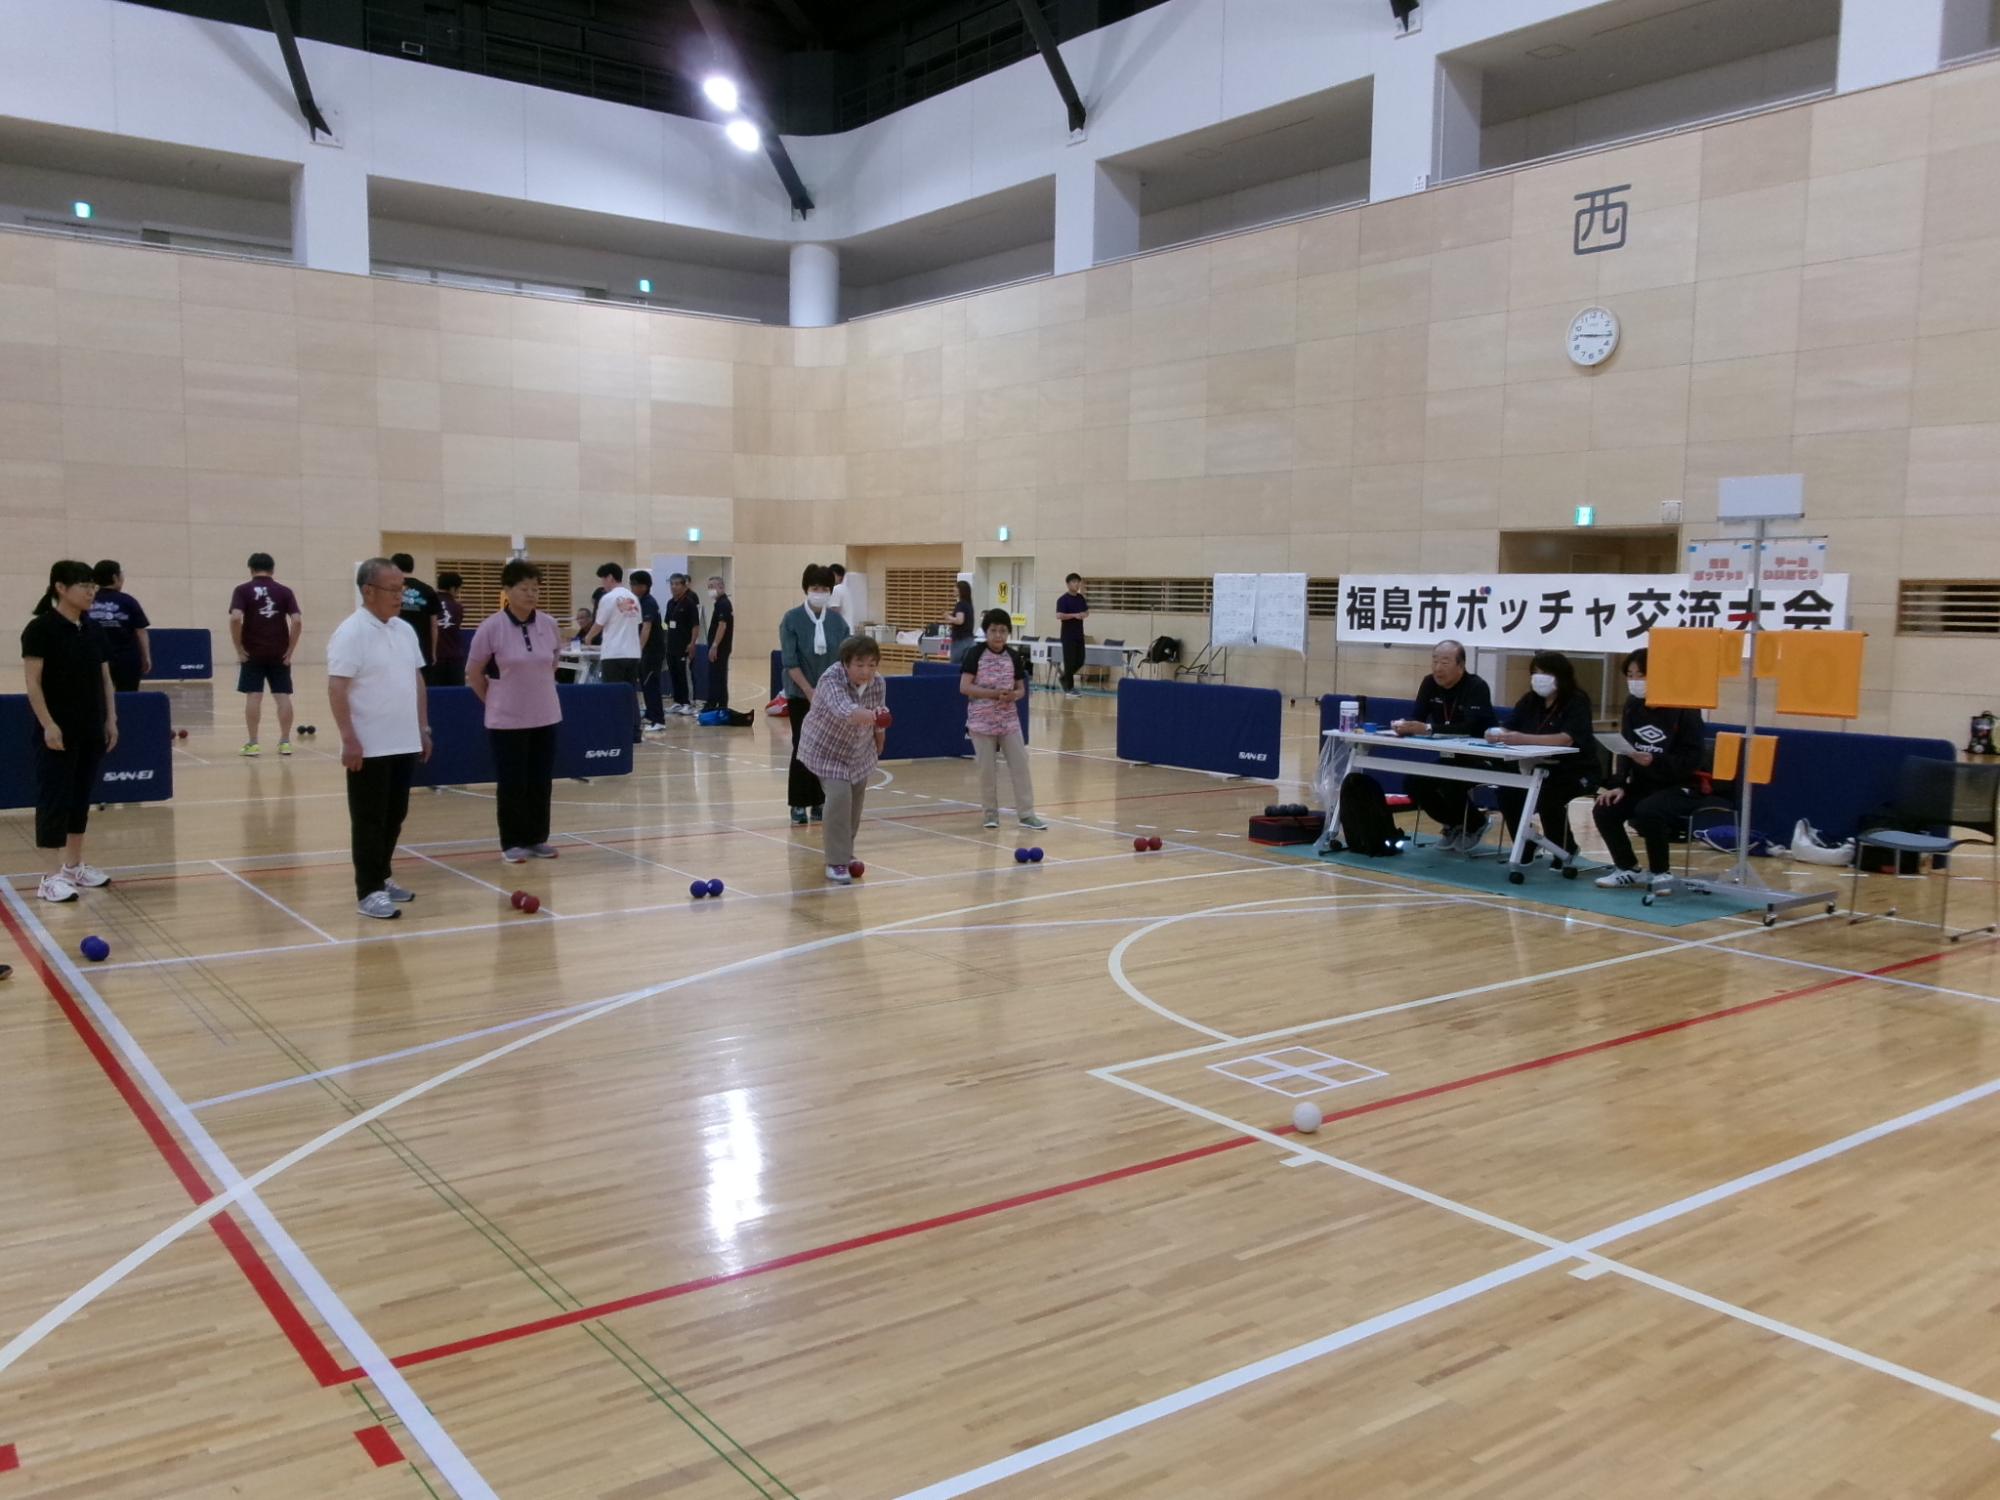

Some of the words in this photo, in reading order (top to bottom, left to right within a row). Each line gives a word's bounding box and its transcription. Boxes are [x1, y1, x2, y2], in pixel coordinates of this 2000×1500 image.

[1574, 184, 1632, 255] 西
[1346, 586, 1834, 639] 福島市ボッチャ交流大会
